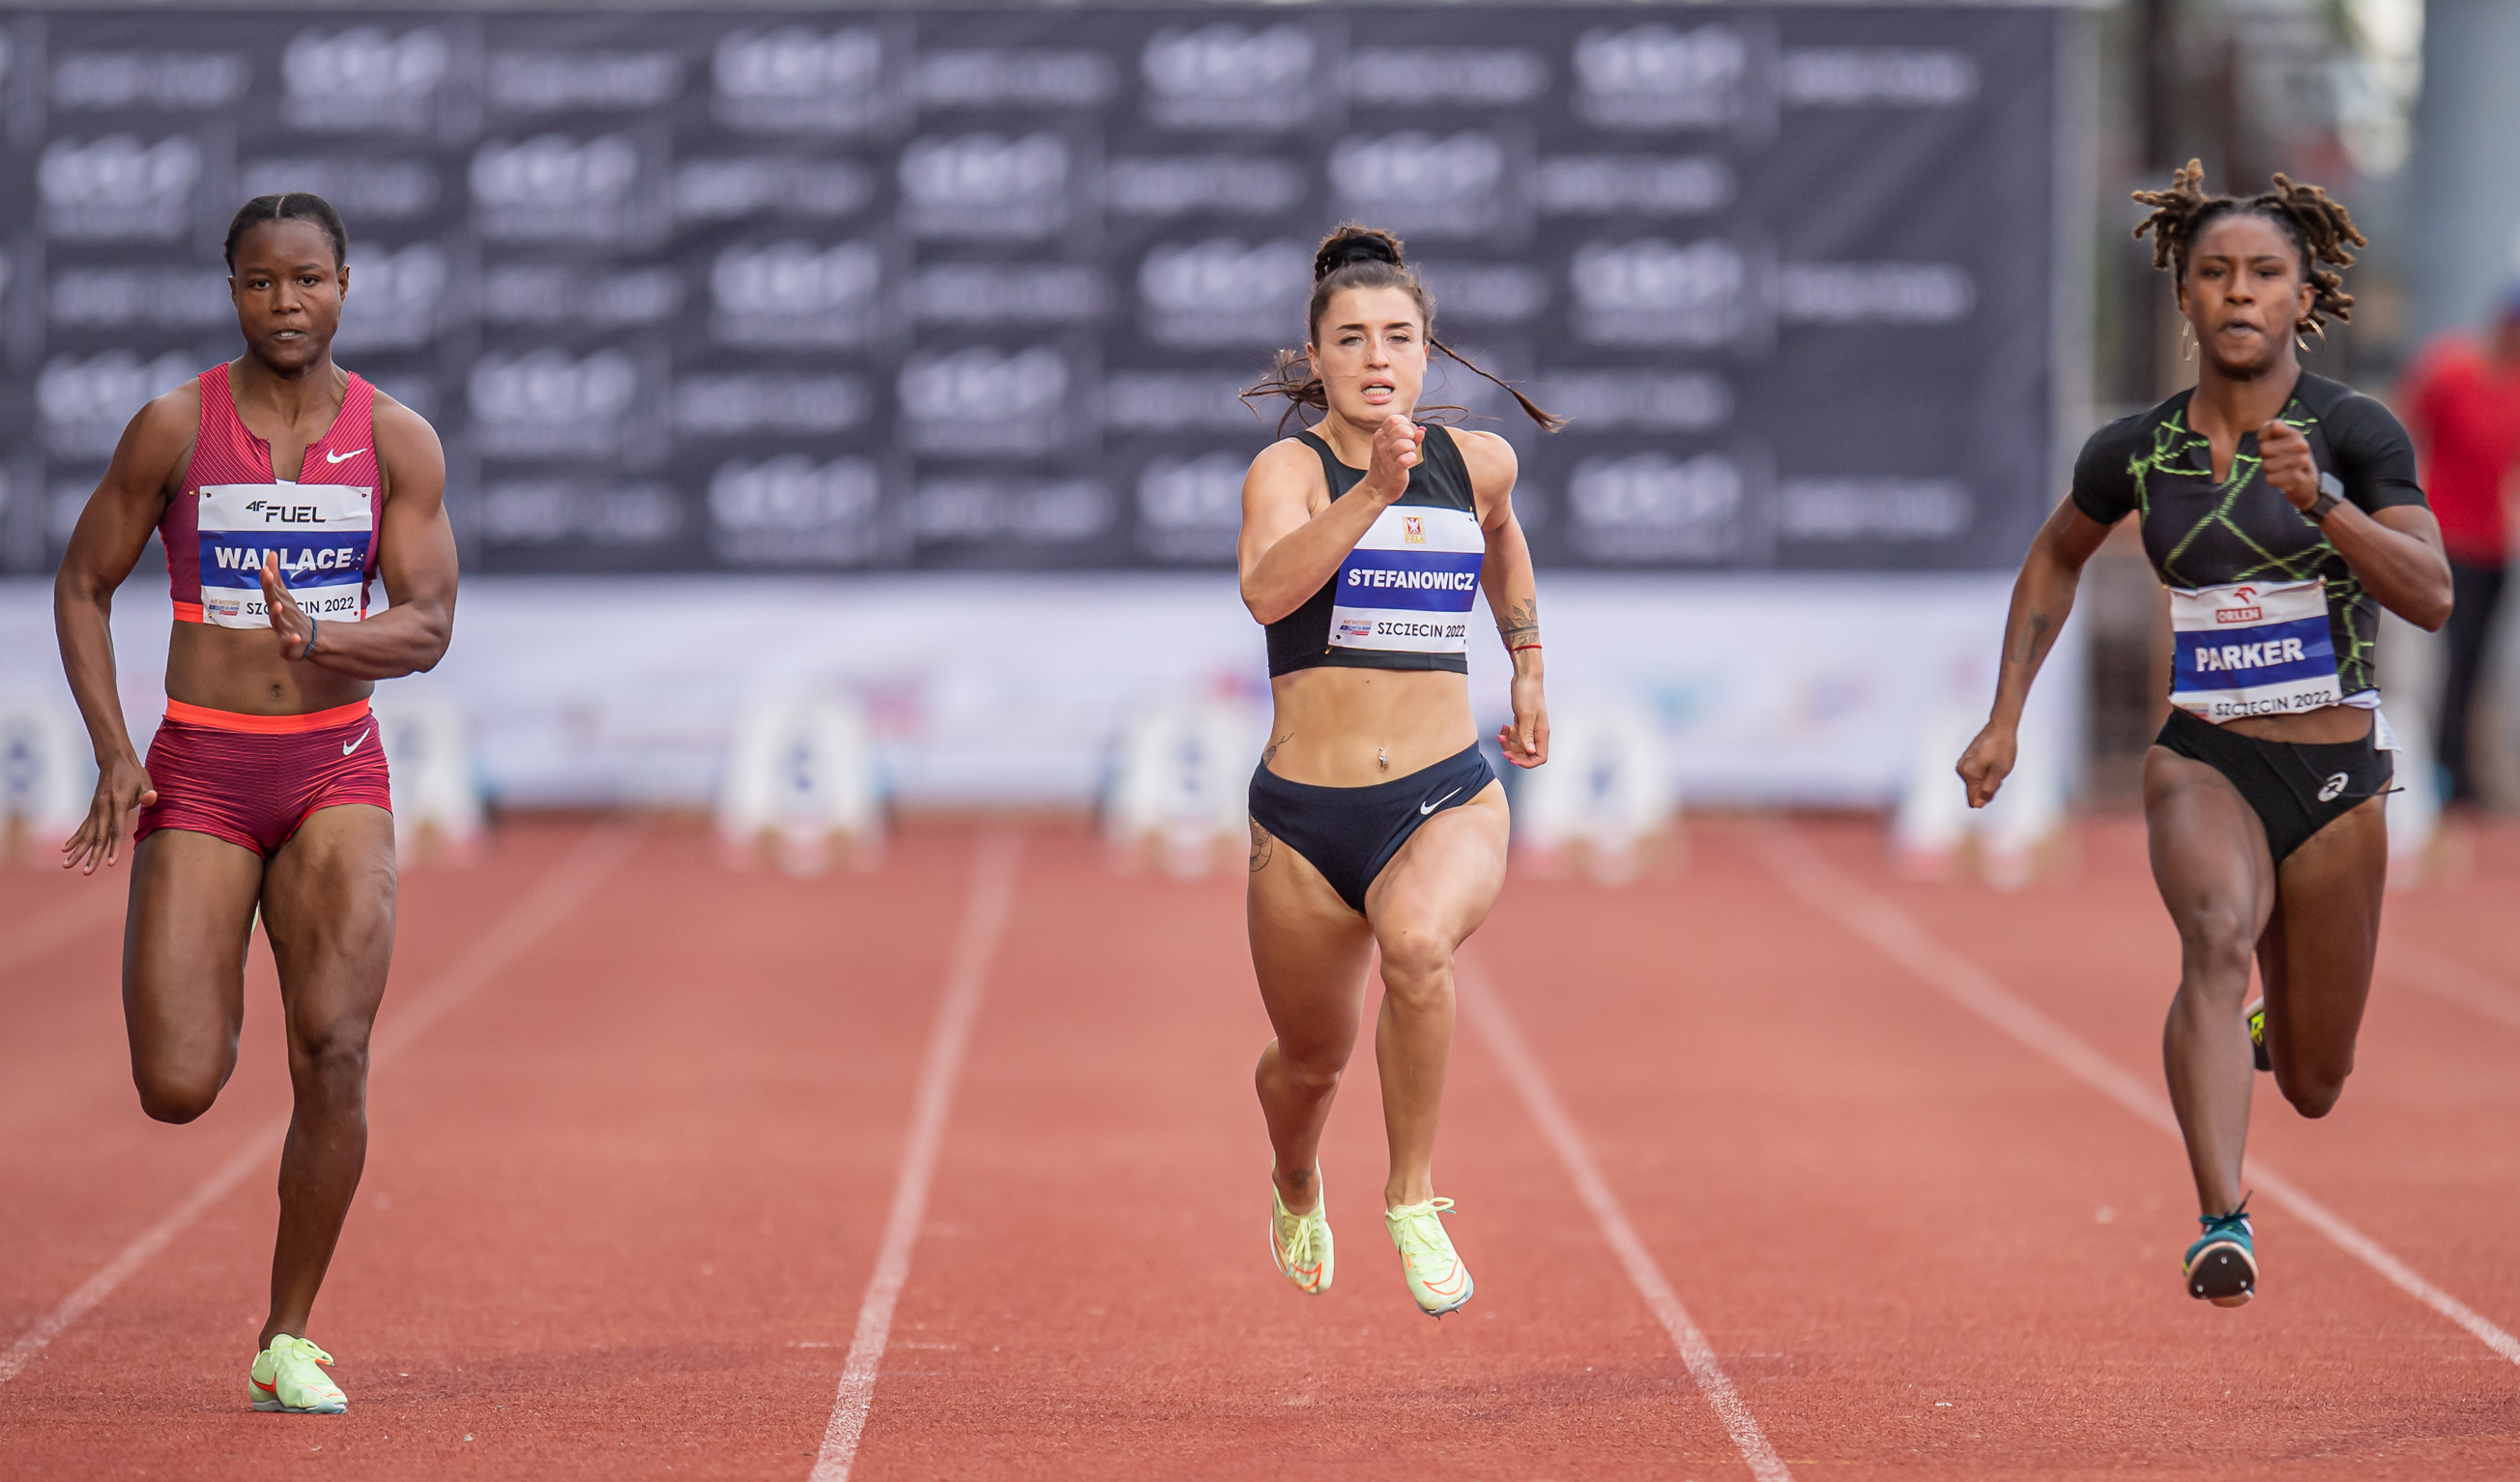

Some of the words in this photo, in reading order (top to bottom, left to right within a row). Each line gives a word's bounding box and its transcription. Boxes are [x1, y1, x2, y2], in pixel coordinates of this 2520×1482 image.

[245, 501, 268, 511] 4F
[266, 506, 327, 523] FUEL
[1347, 568, 1475, 591] STEFANOWICZ
[246, 600, 320, 615] SZIN
[325, 596, 354, 612] 2022
[2218, 609, 2261, 623] ORLEN
[1377, 622, 1443, 638] SZCZECIN
[1445, 625, 1465, 638] 2022
[2194, 637, 2306, 672] PARKER
[2216, 697, 2289, 716] SZCZECIN
[2294, 690, 2332, 709] 2022
